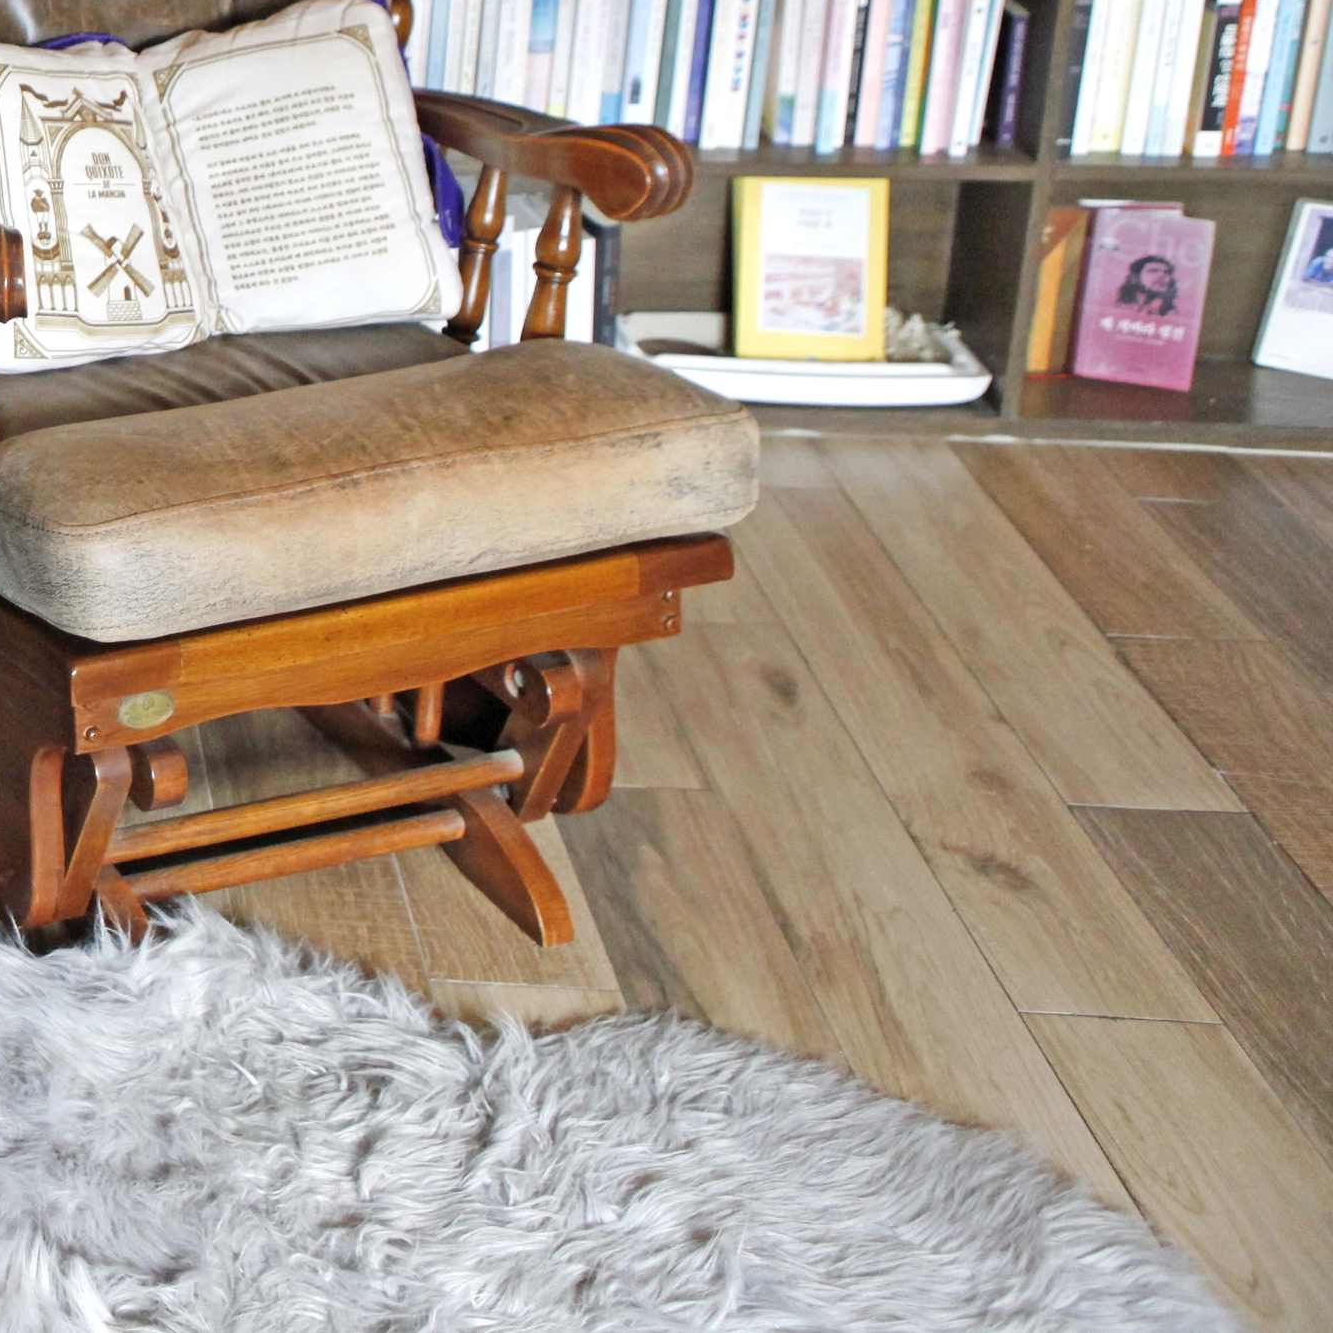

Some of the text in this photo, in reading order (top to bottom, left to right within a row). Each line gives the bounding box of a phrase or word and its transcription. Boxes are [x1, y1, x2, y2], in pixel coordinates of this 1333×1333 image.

[91, 152, 111, 165] DON
[85, 165, 124, 180] QUIXOTE
[88, 189, 126, 198] LA MANCHA
